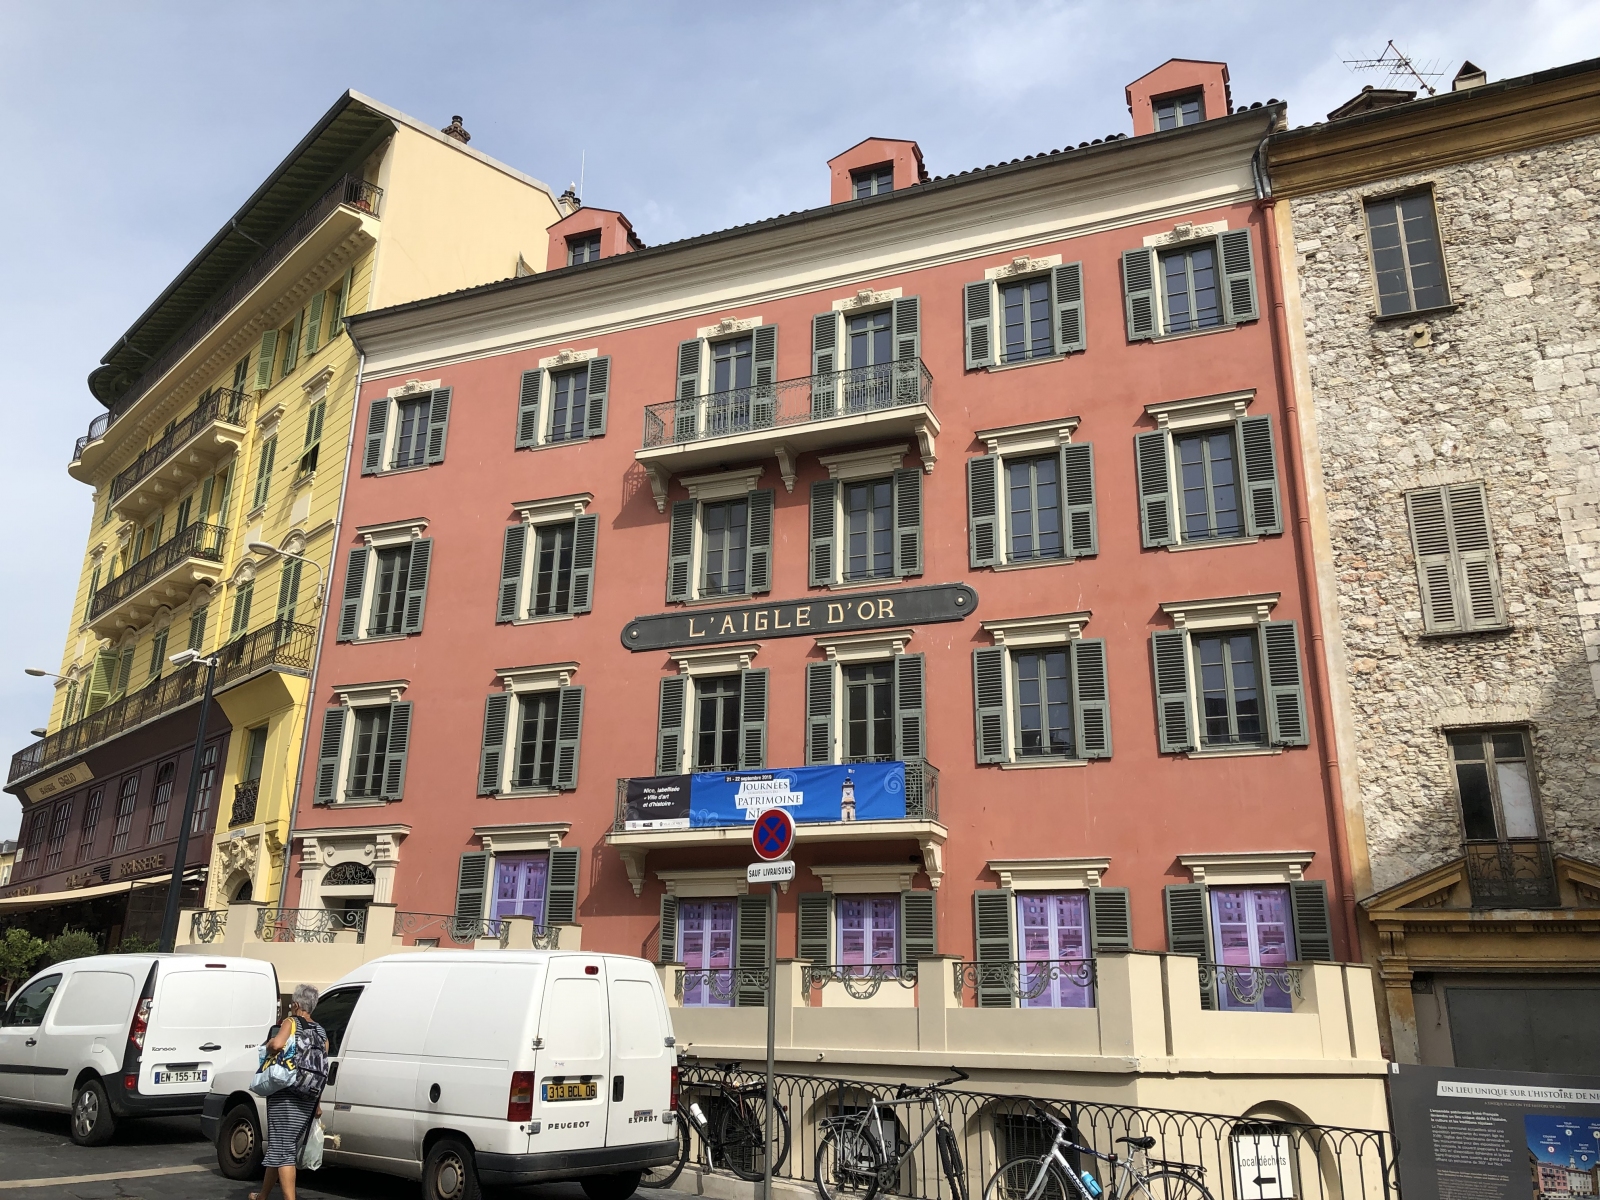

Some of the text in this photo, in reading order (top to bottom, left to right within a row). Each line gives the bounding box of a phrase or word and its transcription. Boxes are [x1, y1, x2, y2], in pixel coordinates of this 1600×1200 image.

[688, 598, 896, 638] L'AIGLE D'OR
[643, 786, 656, 794] Nice,
[742, 780, 788, 793] JOURNÉES
[738, 794, 801, 806] PATRIMOINE
[748, 866, 792, 878] SAUF LIVRAISONS
[549, 1085, 565, 1099] 313
[567, 1085, 582, 1098] BCL
[585, 1084, 596, 1097] 06
[1441, 1085, 1454, 1093] UN
[1456, 1086, 1474, 1094] LIEU
[1475, 1087, 1508, 1096] UNIQUE
[1510, 1089, 1526, 1097] SUR
[1589, 1093, 1600, 1101] NI
[628, 1115, 658, 1123] EXPERT
[547, 1121, 590, 1130] PEUGEOT
[1259, 1155, 1287, 1167] déchts
